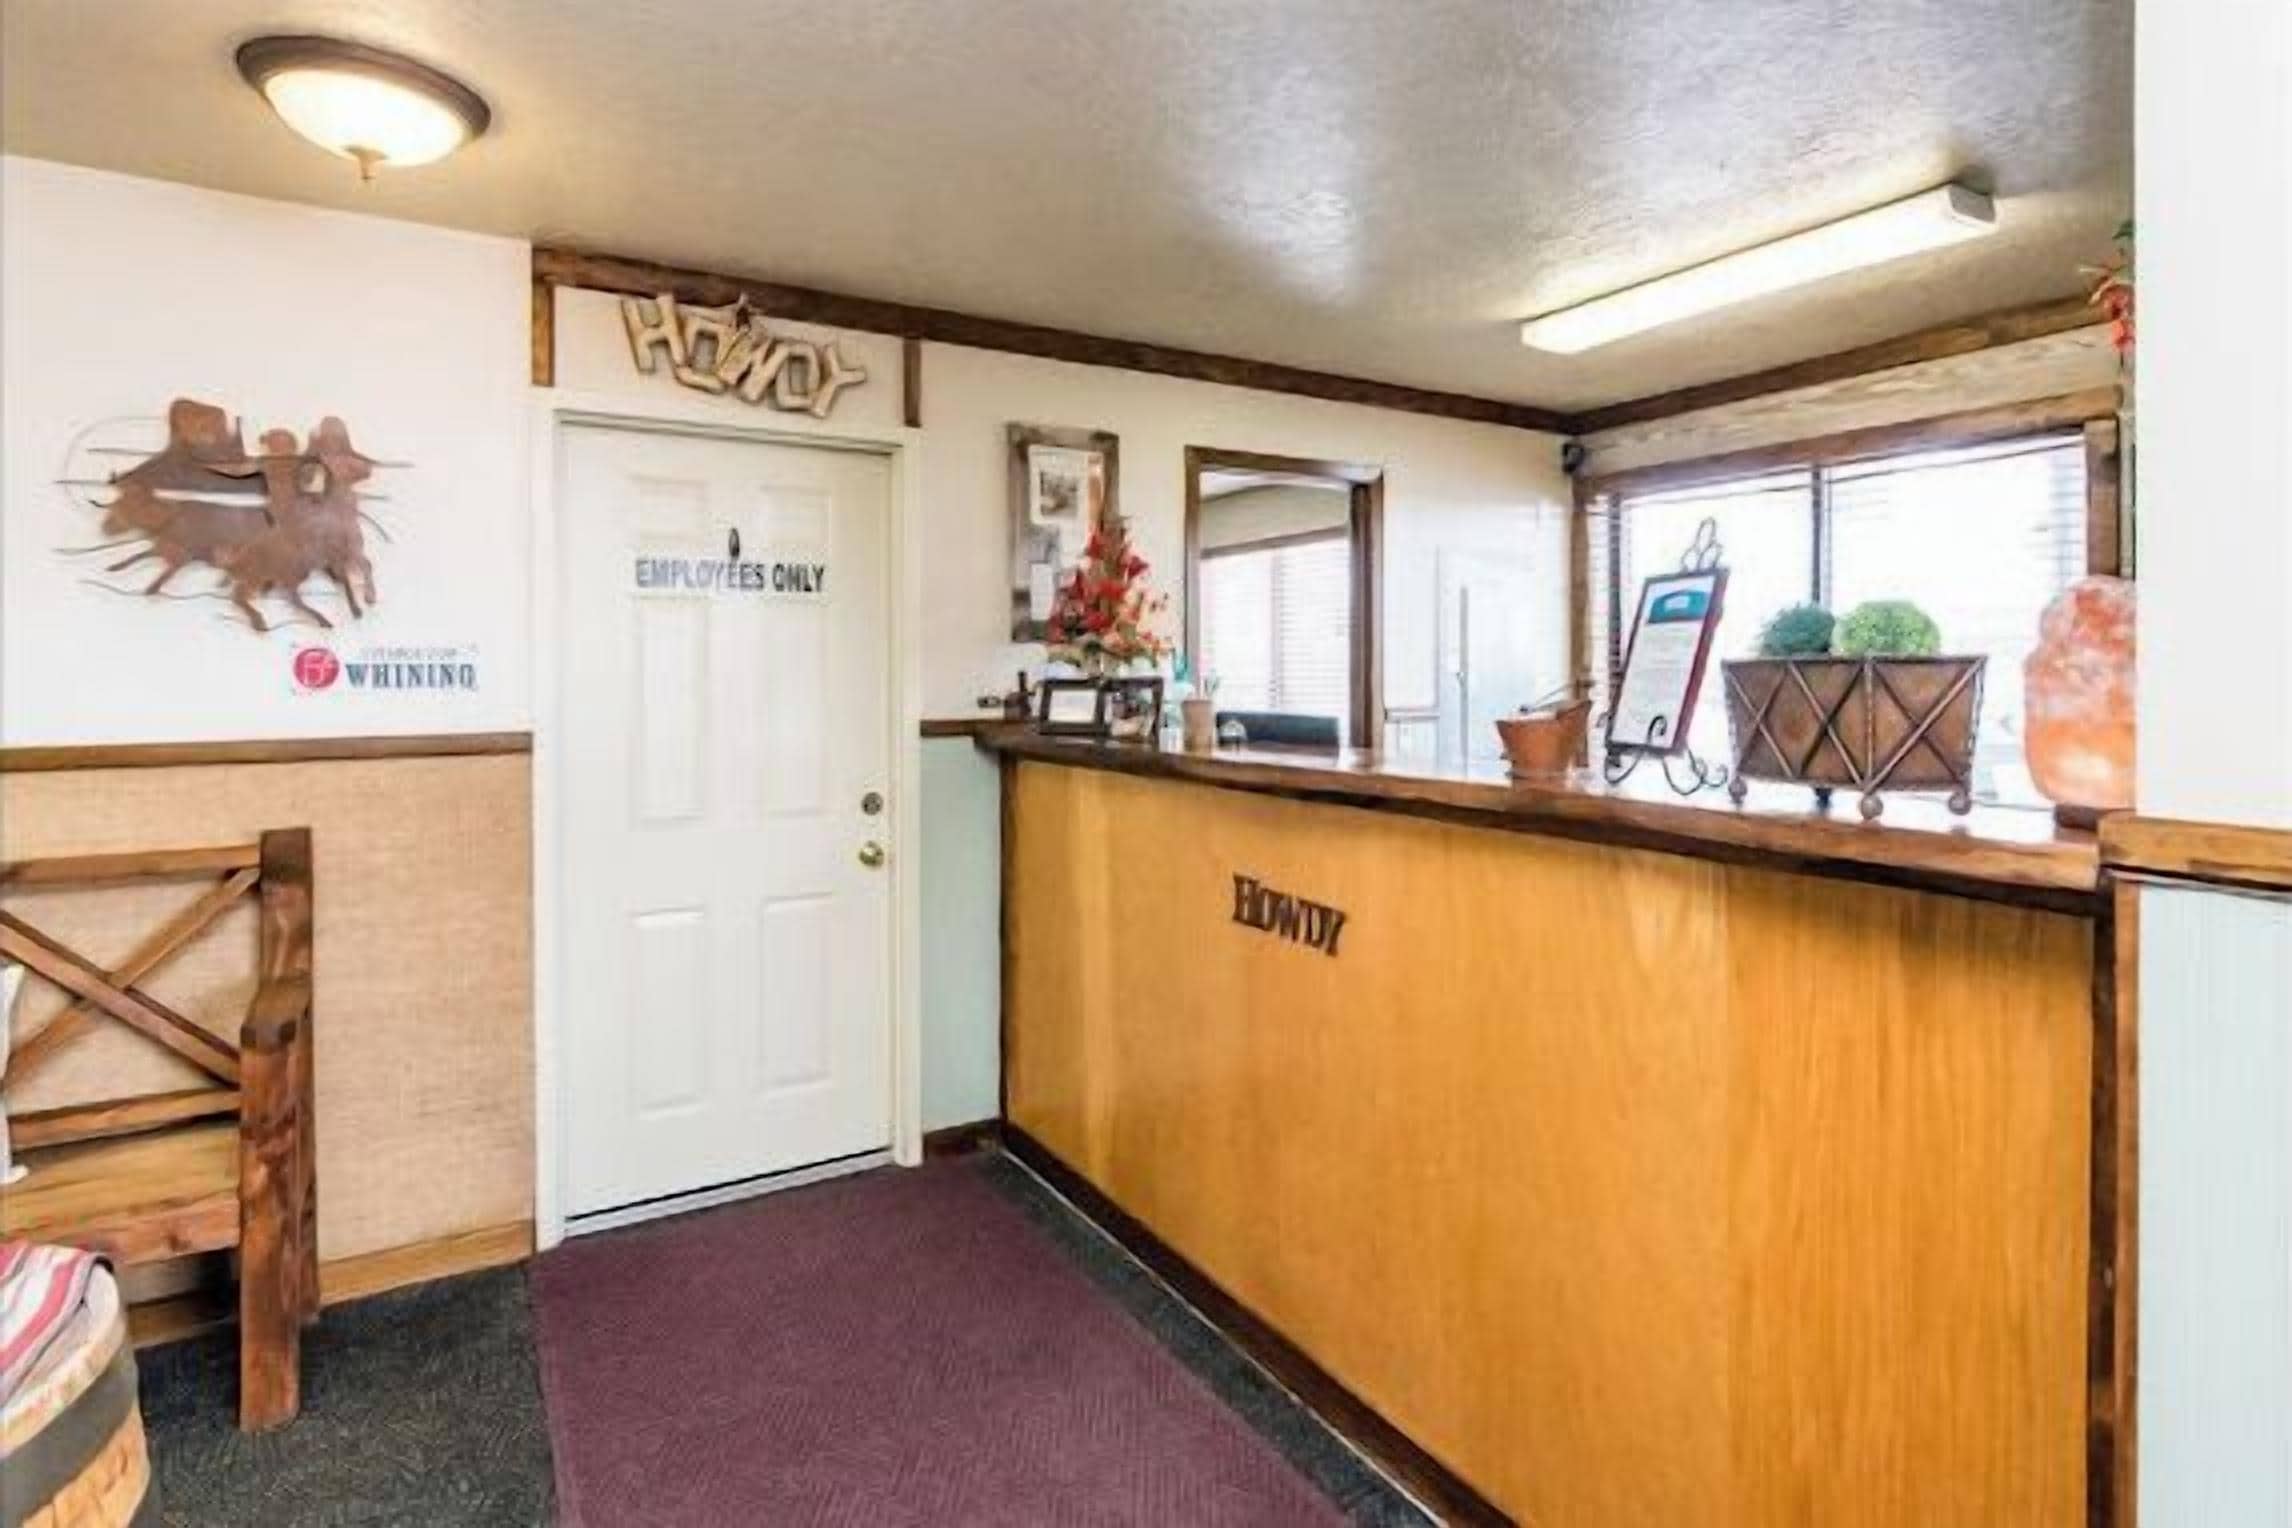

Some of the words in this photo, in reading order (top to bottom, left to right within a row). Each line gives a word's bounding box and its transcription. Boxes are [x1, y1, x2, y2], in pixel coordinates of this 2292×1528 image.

[621, 292, 867, 419] HOWDY
[635, 558, 765, 590] EMPLOYEES
[772, 562, 824, 592] ONLY
